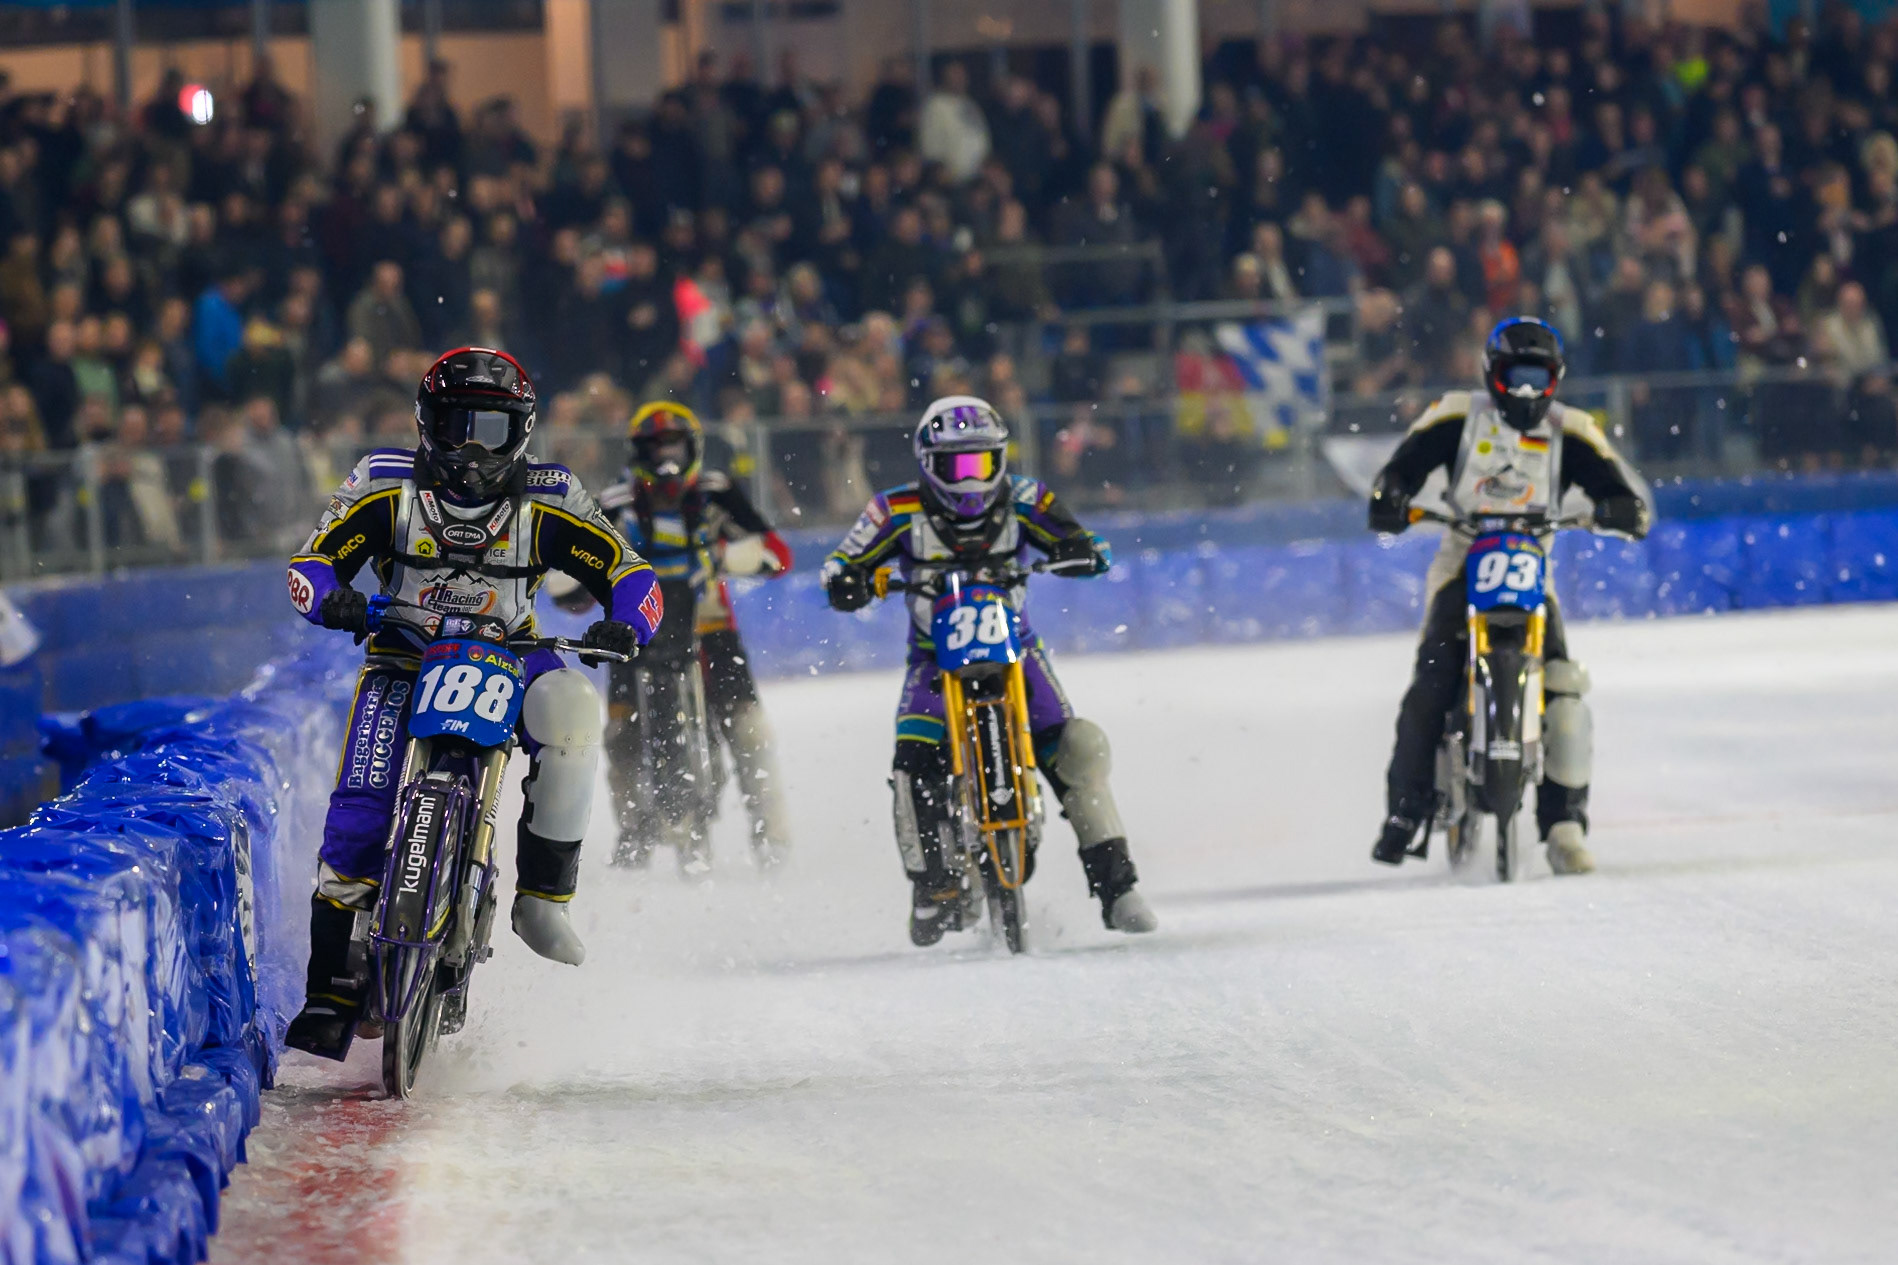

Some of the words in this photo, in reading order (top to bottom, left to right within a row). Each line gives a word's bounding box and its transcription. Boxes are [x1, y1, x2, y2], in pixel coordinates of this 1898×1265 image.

[526, 469, 570, 481] eam
[570, 545, 605, 570] WACO
[1474, 551, 1539, 594] 93
[946, 604, 1009, 651] 38
[416, 664, 514, 723] 188
[441, 718, 470, 733] FIM
[400, 796, 437, 894] kugelmann
